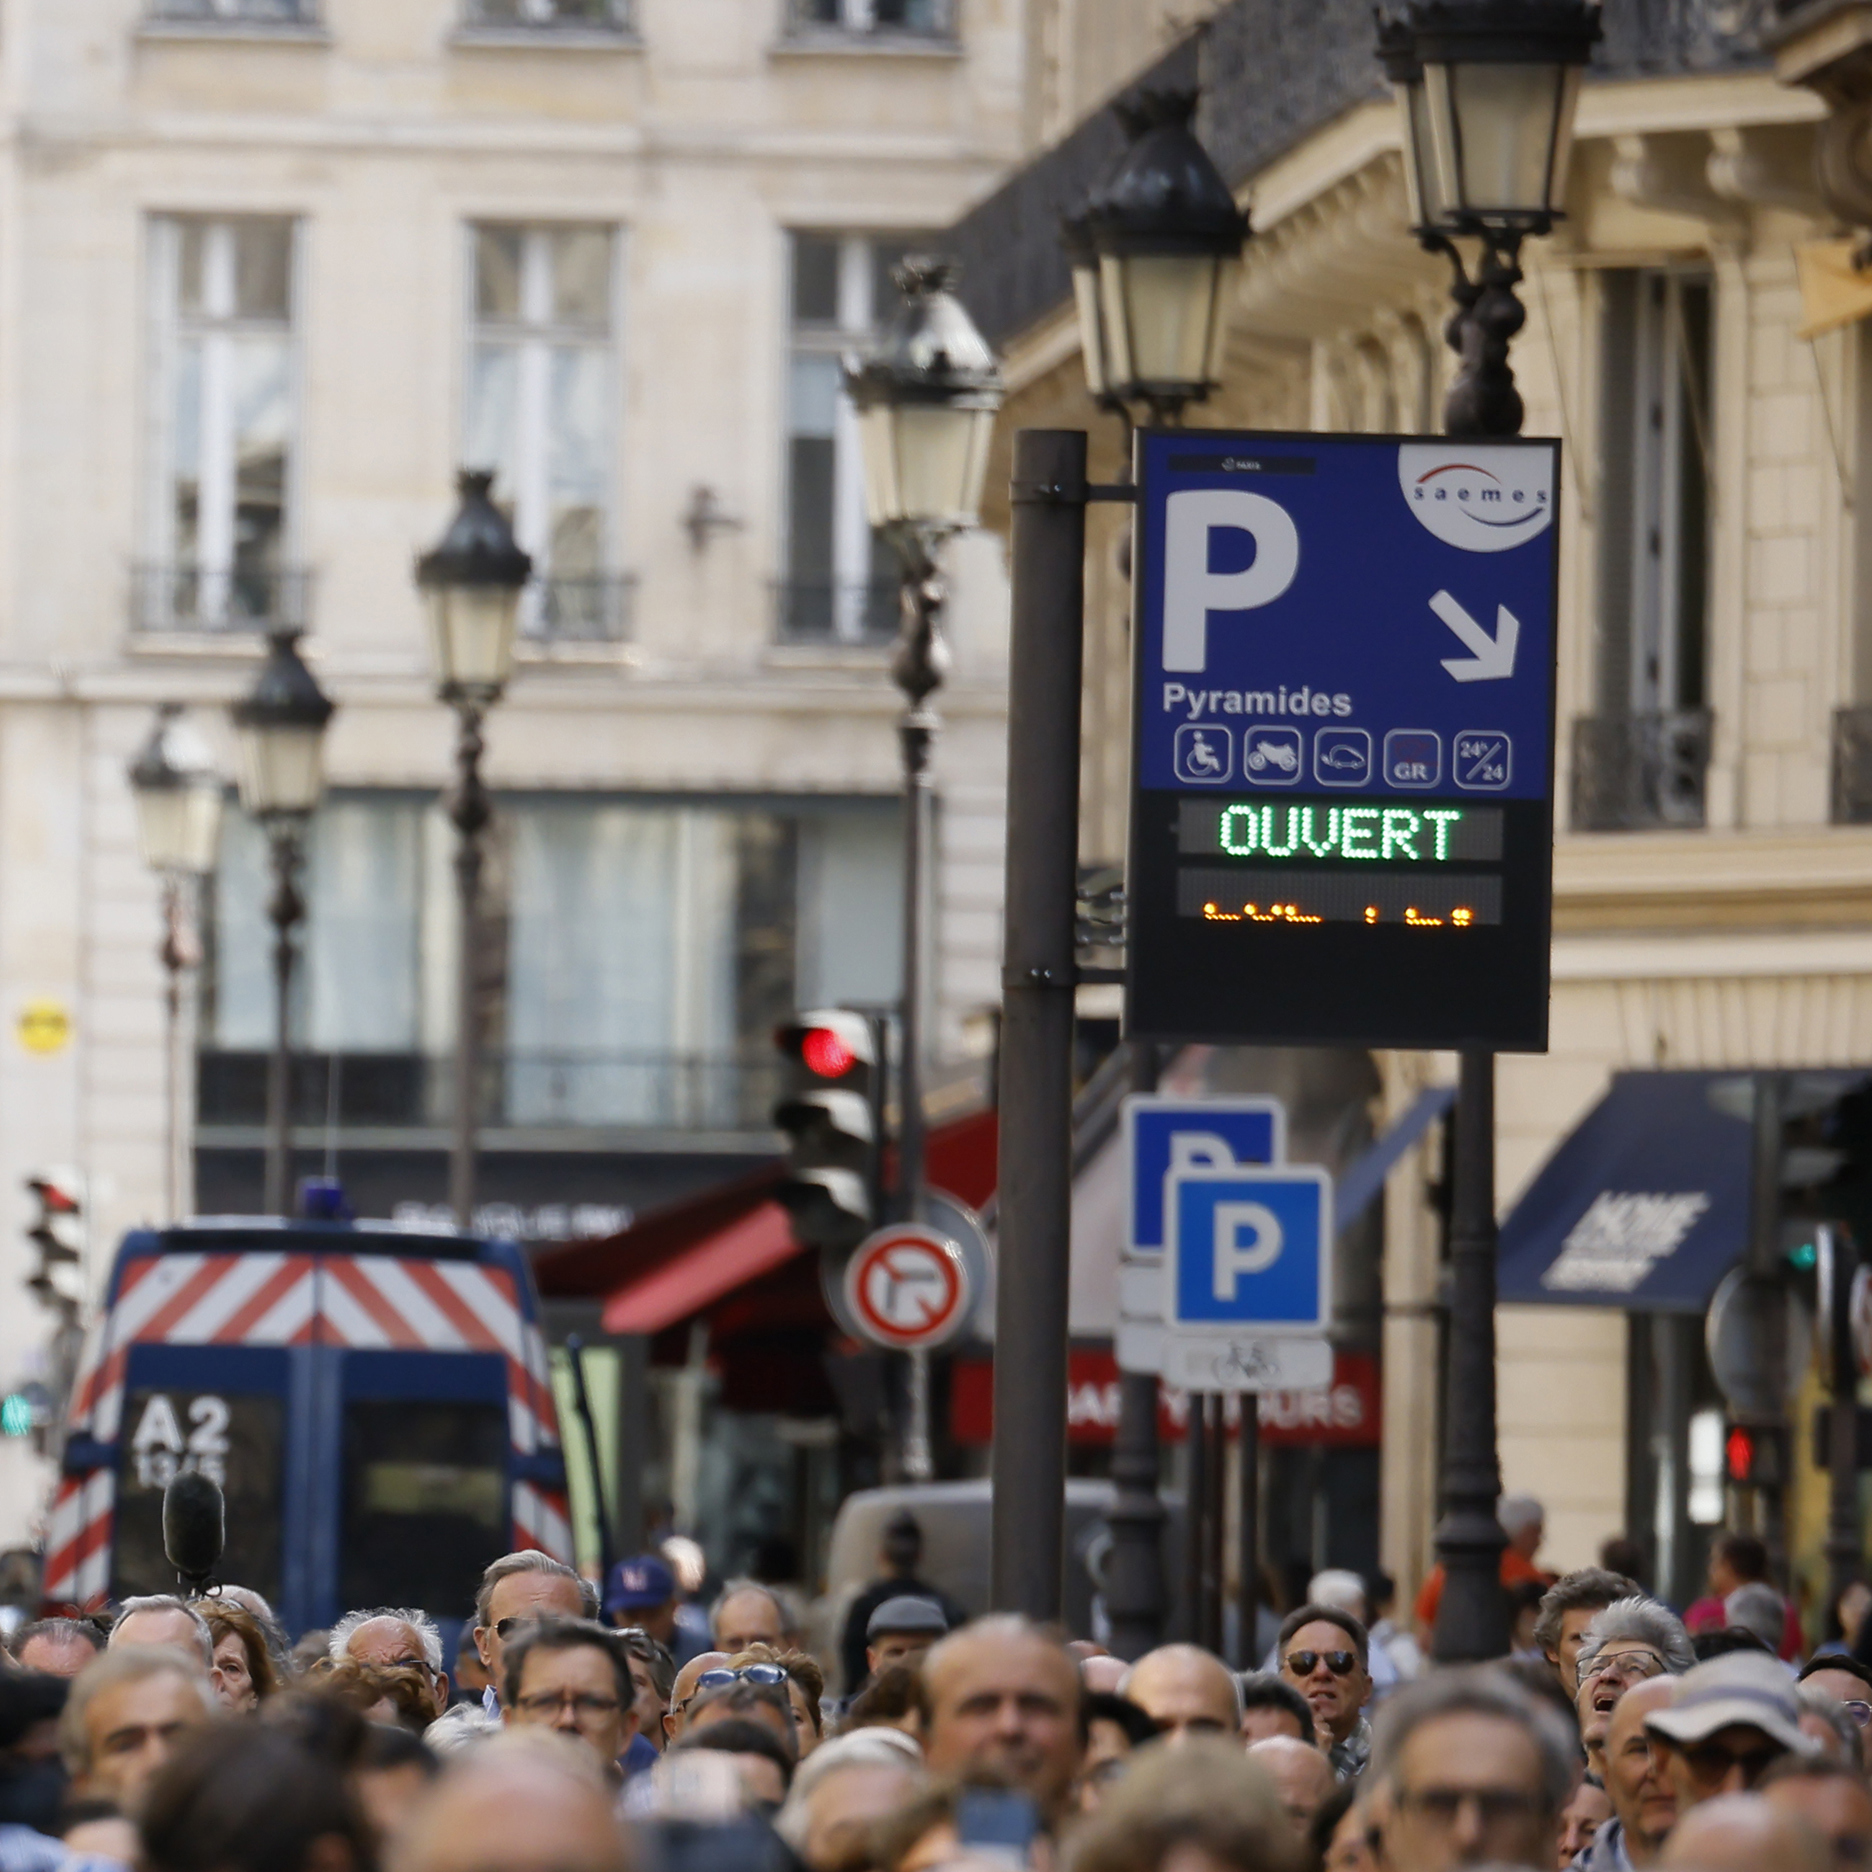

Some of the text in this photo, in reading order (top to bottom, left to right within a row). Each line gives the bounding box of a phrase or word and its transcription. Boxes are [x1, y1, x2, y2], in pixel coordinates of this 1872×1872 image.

[1414, 484, 1547, 504] saemes
[1162, 488, 1299, 673] P
[1162, 682, 1353, 720] Pyramides
[1393, 761, 1429, 781] GR
[1219, 804, 1463, 862] OUVERT
[1212, 1200, 1283, 1302] P
